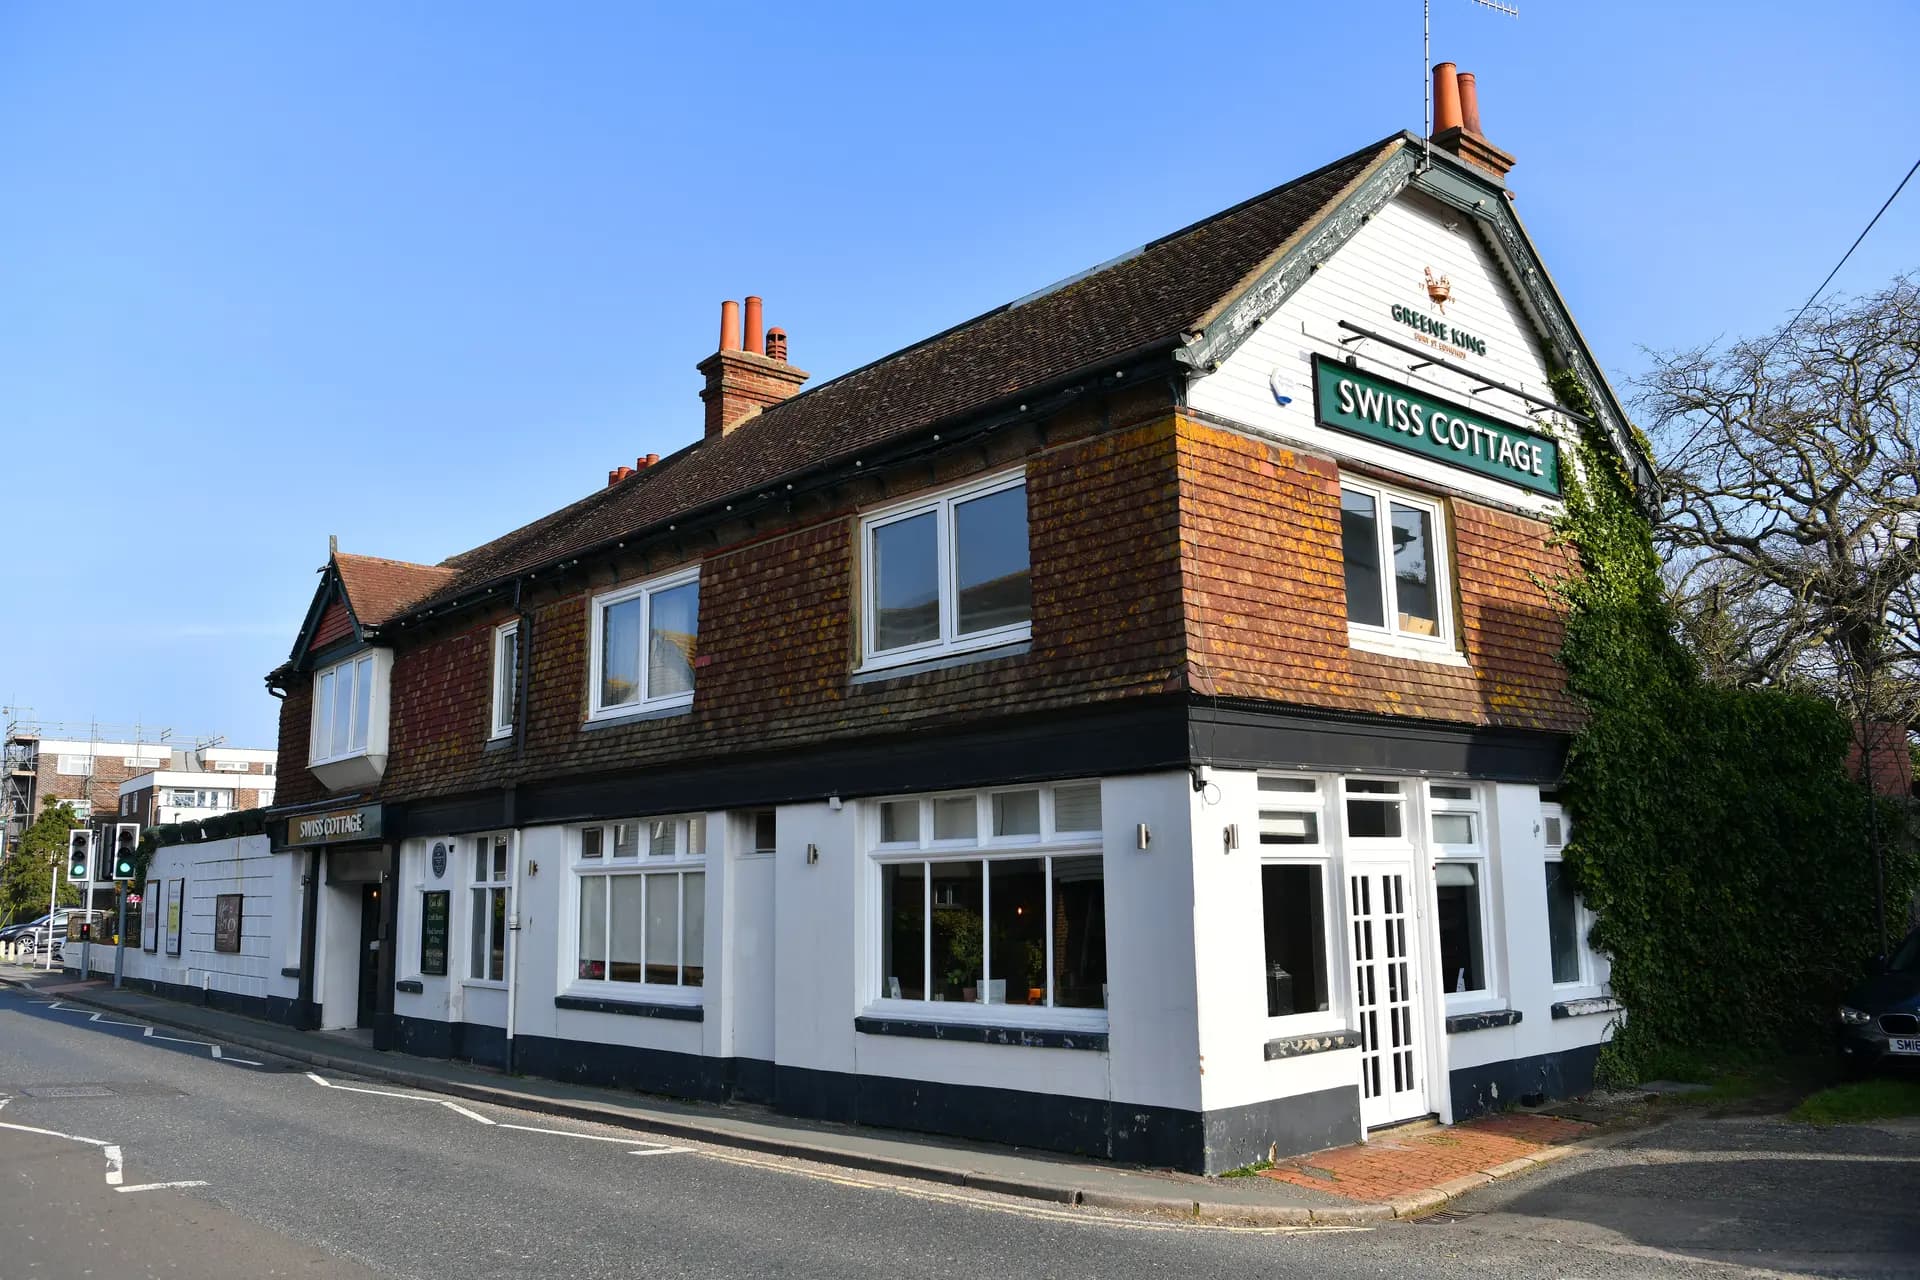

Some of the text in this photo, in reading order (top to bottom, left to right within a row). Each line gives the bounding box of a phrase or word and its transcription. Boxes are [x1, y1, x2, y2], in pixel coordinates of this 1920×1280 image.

[1391, 303, 1448, 341] GREENE
[1451, 327, 1487, 357] KING
[1339, 379, 1544, 476] SWISS COTTAGE
[299, 813, 362, 838] SWISS COTTAGE
